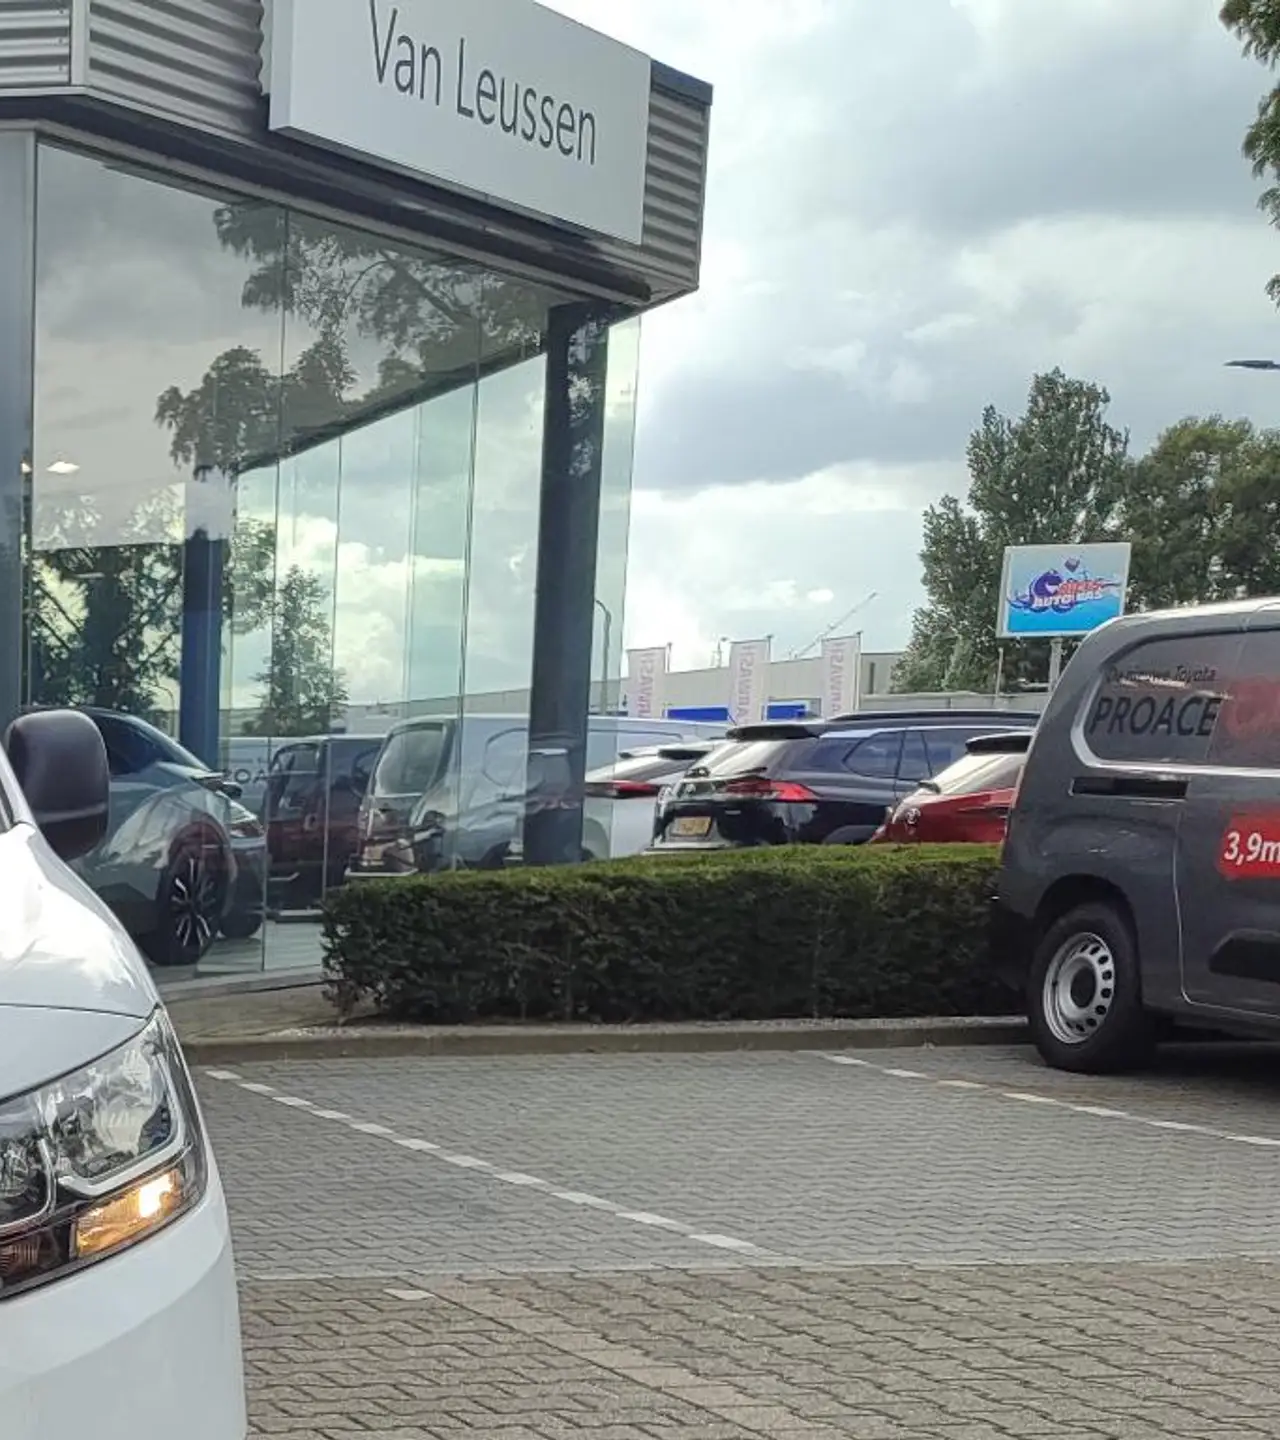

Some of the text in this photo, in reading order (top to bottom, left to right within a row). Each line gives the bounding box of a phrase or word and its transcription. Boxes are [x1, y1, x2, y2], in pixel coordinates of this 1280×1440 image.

[370, 0, 596, 165] Van Leussen
[1090, 696, 1222, 736] PROACE
